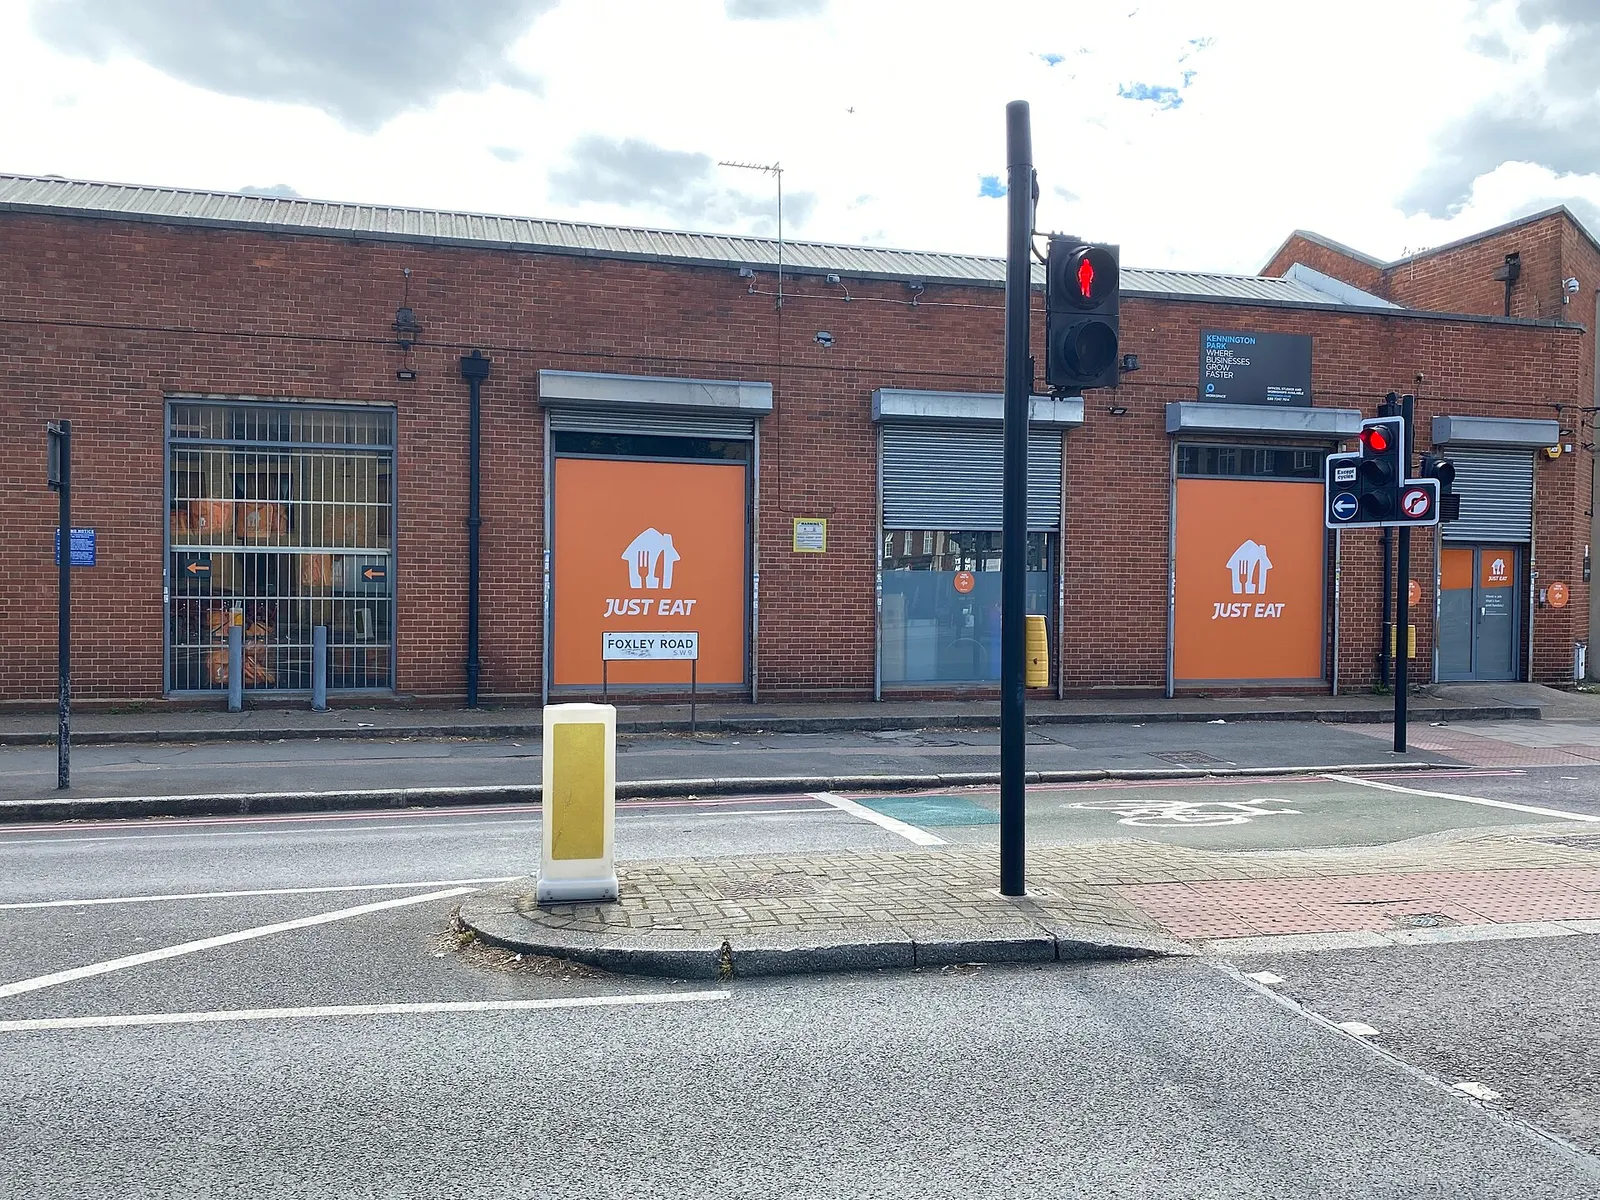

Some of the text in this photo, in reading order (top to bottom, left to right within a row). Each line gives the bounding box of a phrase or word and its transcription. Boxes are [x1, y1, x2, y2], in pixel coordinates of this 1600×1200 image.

[1206, 335, 1256, 344] KENNINGTON
[1206, 349, 1234, 357] WHERE
[1206, 356, 1251, 366] BUSINESSES
[1205, 363, 1230, 371] GROW
[1205, 371, 1234, 379] FASTER
[603, 598, 697, 618] JUST EAT
[1211, 602, 1286, 620] JUST EAT
[607, 639, 694, 649] FOXLEY ROAD
